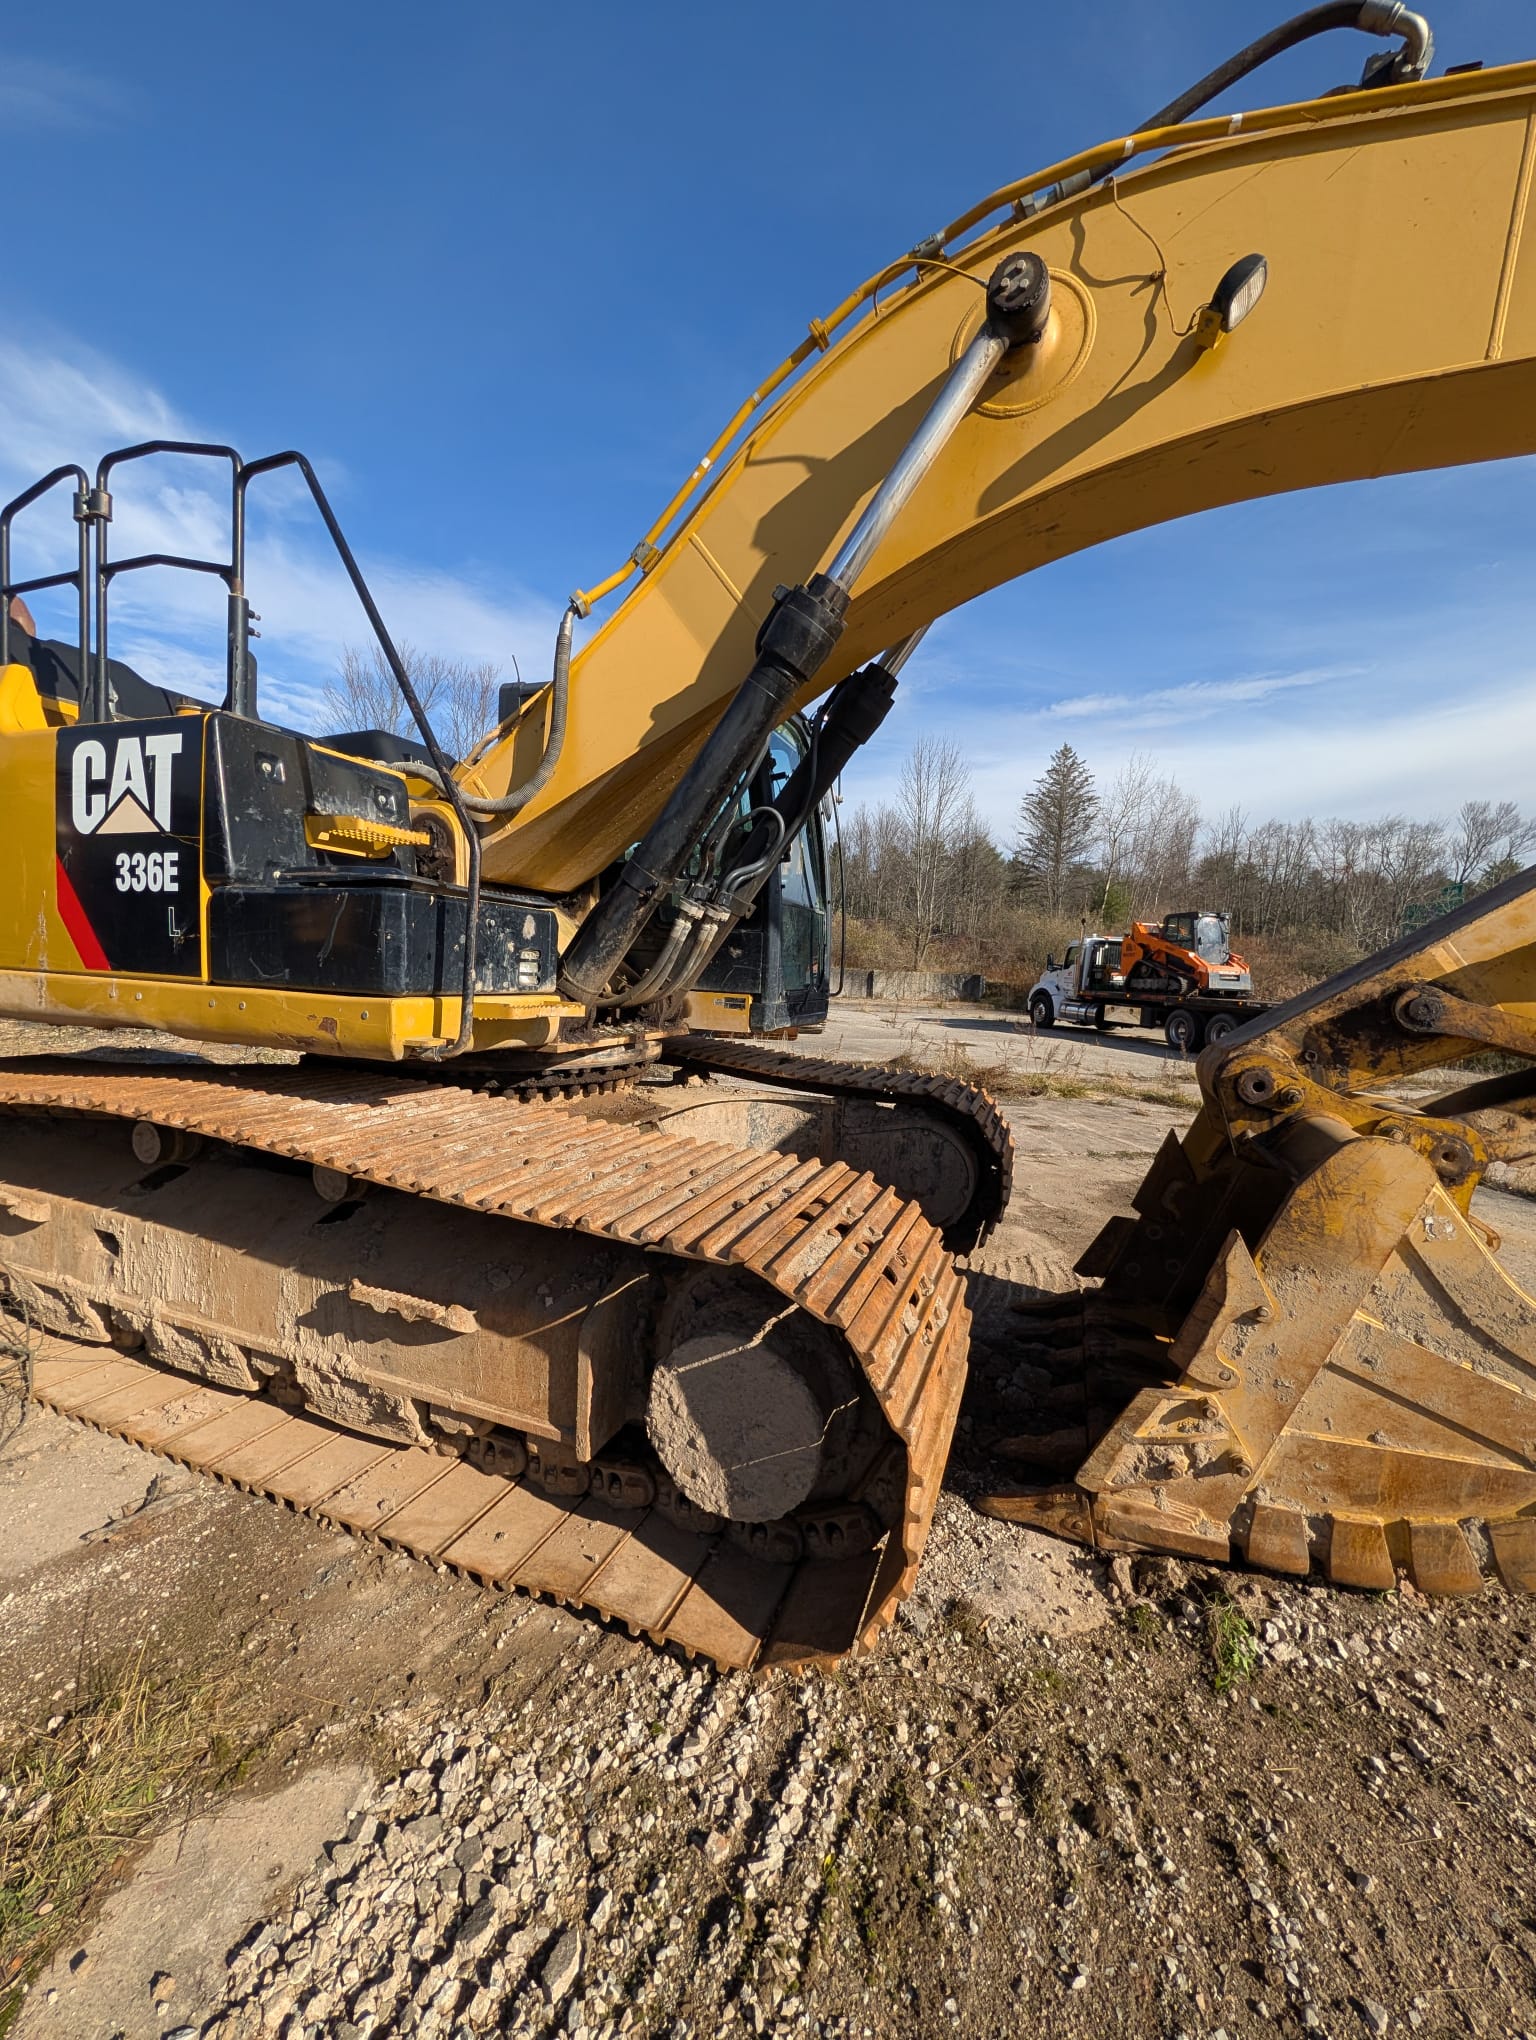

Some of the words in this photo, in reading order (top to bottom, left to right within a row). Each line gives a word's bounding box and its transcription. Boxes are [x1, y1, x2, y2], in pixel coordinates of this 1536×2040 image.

[72, 733, 182, 835] CAT
[115, 852, 179, 892] 336E
[168, 906, 181, 937] L
